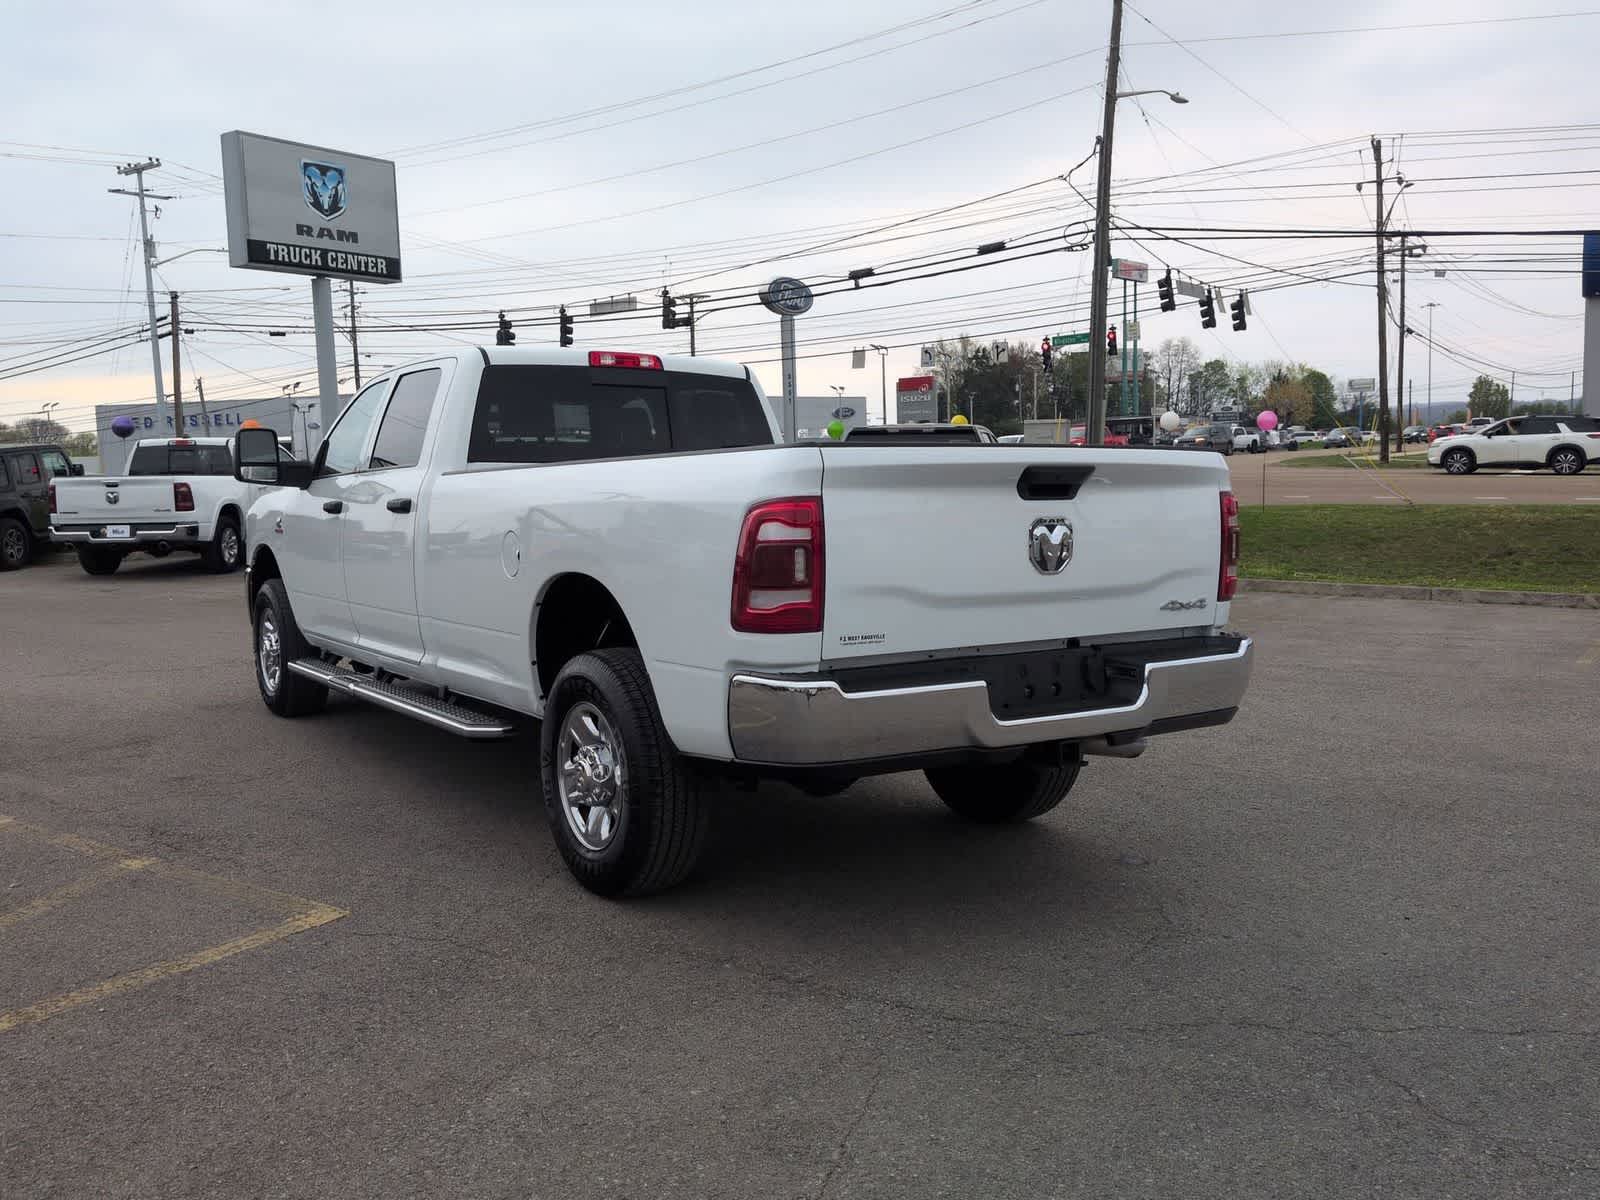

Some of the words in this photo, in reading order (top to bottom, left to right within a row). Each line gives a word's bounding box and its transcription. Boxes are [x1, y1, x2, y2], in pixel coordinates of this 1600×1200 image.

[296, 223, 359, 244] RAM
[266, 243, 323, 266] TRUCK
[327, 251, 388, 275] CENTER
[778, 283, 805, 308] Ford
[166, 413, 241, 428] RSSELL
